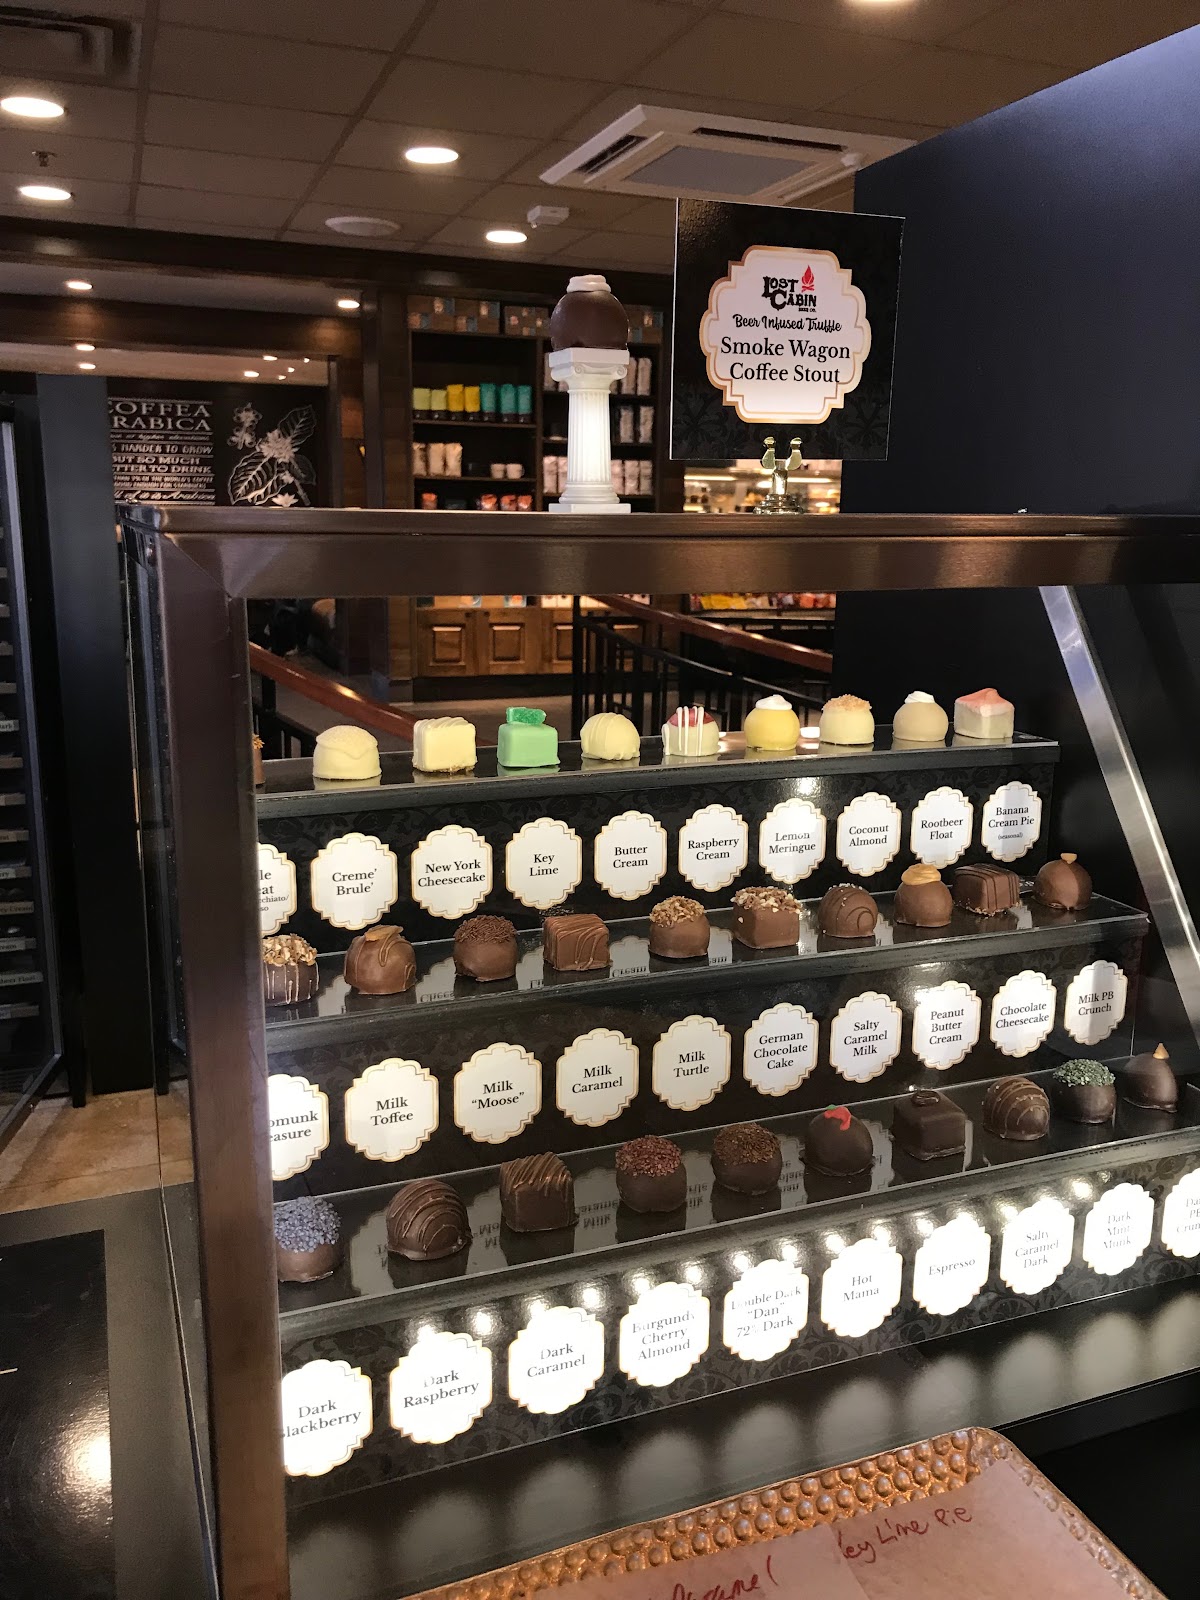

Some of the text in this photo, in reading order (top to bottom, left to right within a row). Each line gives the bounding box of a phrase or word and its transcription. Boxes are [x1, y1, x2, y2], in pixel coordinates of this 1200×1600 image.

[762, 276, 799, 298] LOST
[770, 289, 817, 311] CABIN
[733, 314, 842, 332] Beer Infused Truffle
[721, 336, 850, 362] Smoke Wagon
[730, 362, 840, 383] Coffee Stout
[113, 415, 211, 431] RABICA
[171, 466, 212, 474] DRINK
[996, 806, 1029, 816] Banana
[921, 816, 964, 828] Rootbeer
[988, 816, 1034, 828] Cream Pie
[849, 824, 889, 835] Coconut
[930, 830, 953, 840] Float
[688, 837, 740, 850] Raspberry
[775, 832, 810, 842] Lemon
[849, 834, 888, 847] Almond
[614, 846, 648, 856] Butter
[696, 850, 730, 861] Cream
[768, 842, 816, 855] Meringue
[533, 853, 555, 866] Key
[612, 858, 648, 868] Cream
[425, 860, 482, 874] New York
[530, 866, 559, 876] Lime
[417, 872, 486, 888] Cheesecake
[1078, 990, 1114, 1005] Milk PB
[930, 1008, 964, 1020] Peanut
[1000, 1002, 1047, 1017] Chocolate
[1078, 1004, 1112, 1016] Crunch
[853, 1020, 880, 1033] Salty
[931, 1020, 962, 1033] Butter
[996, 1014, 1050, 1030] Cheesecake
[758, 1031, 804, 1046] German
[844, 1031, 888, 1046] Caramel
[929, 1032, 962, 1046] Cream
[678, 1050, 706, 1064] Milk
[754, 1044, 808, 1060] Chocolate
[853, 1045, 878, 1058] Milk
[766, 1057, 794, 1070] Cake
[584, 1064, 612, 1078] Milk
[673, 1064, 710, 1078] Turtle
[482, 1080, 514, 1095] Milk
[572, 1076, 623, 1094] Caramel
[376, 1096, 408, 1112] Milk
[370, 1110, 414, 1127] Toffee
[1107, 1211, 1132, 1224] Dark
[1026, 1230, 1050, 1244] Salty
[1015, 1240, 1060, 1258] Caramel
[928, 1258, 976, 1277] Espresso
[1024, 1256, 1048, 1269] Dark
[852, 1274, 873, 1287] Hot
[843, 1287, 880, 1302] Mama
[763, 1316, 794, 1332] Dark
[642, 1327, 688, 1346] Cherry
[540, 1343, 574, 1360] Dark
[638, 1339, 690, 1361] Almond
[527, 1354, 586, 1378] Caramel
[423, 1369, 460, 1388] Dark
[404, 1381, 480, 1409] Raspberry
[298, 1399, 338, 1419] Dark
